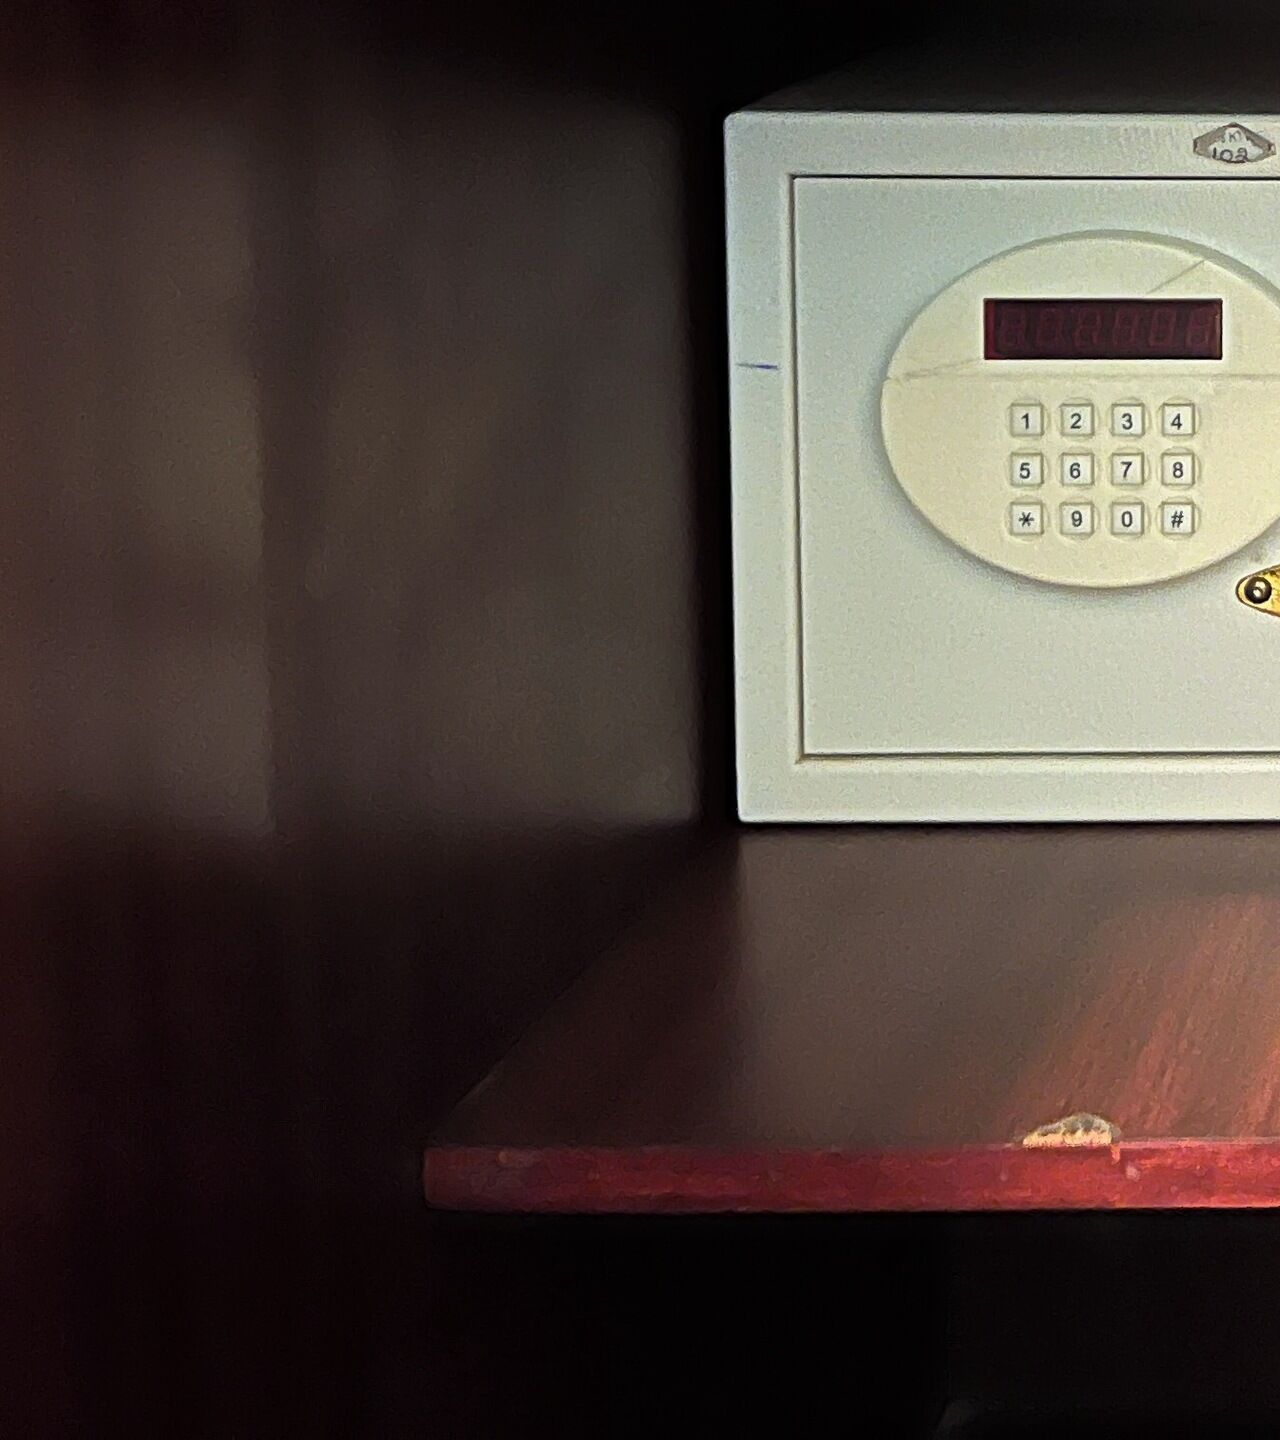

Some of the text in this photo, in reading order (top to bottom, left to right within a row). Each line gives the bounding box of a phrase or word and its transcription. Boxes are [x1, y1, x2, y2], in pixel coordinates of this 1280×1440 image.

[1020, 414, 1183, 430] 1 2 3 4
[1020, 463, 1184, 479] 5 6 7 8
[1070, 511, 1081, 528] 9
[1121, 511, 1133, 528] 0
[1171, 511, 1183, 528] #
